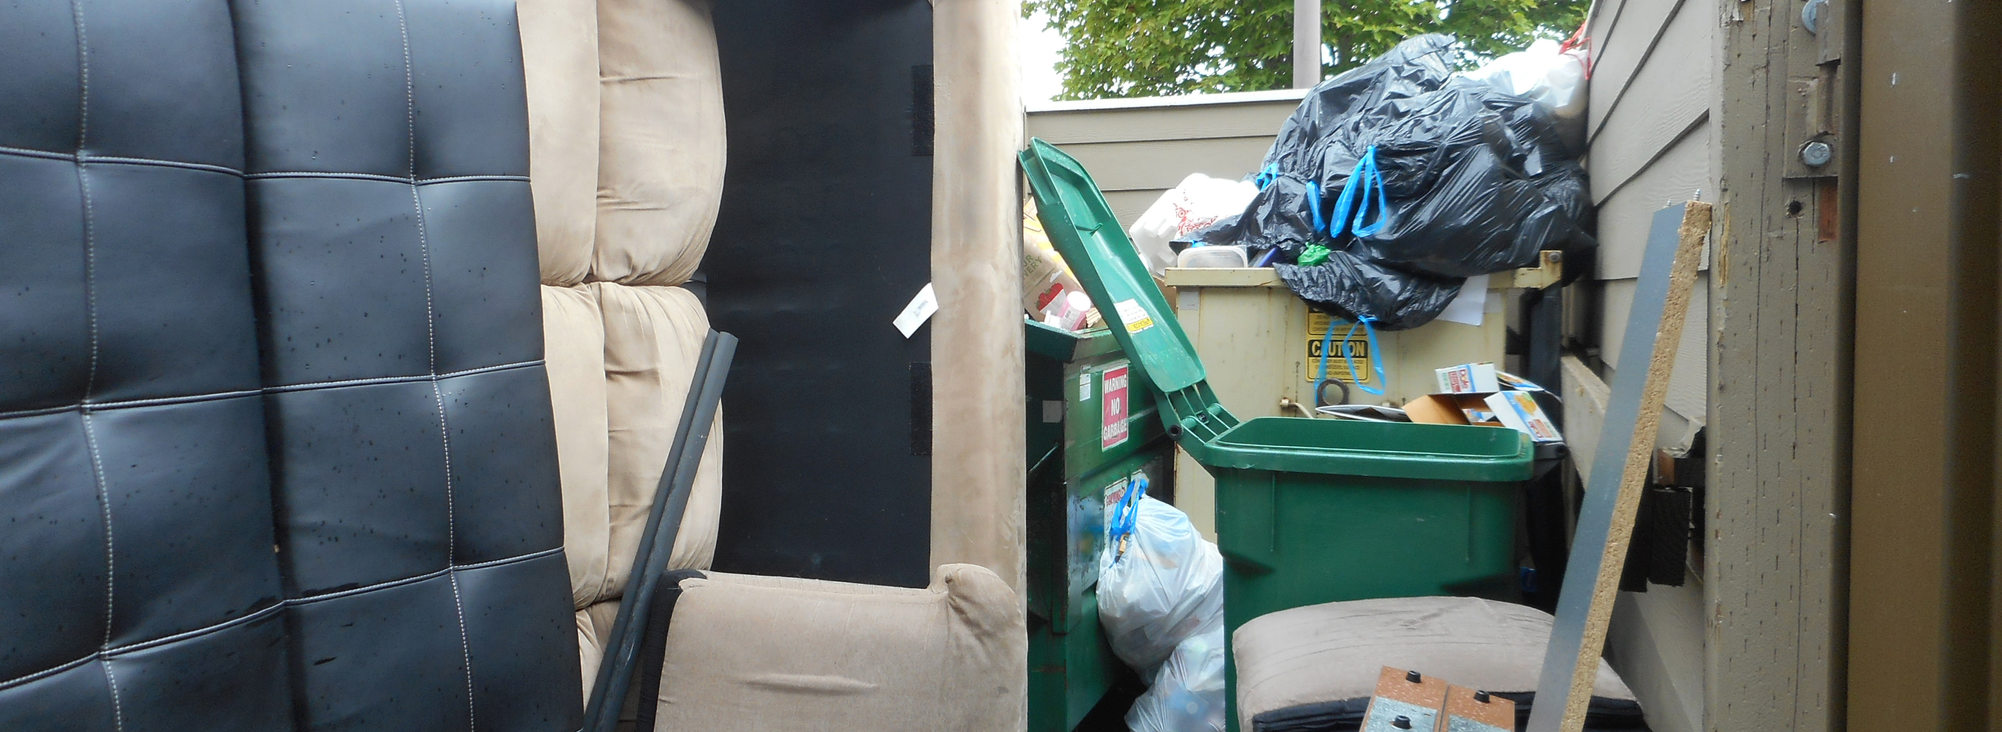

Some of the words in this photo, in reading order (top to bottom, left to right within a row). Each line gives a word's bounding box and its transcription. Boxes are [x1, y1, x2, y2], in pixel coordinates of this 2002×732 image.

[1312, 341, 1365, 356] CUTON
[1104, 374, 1127, 394] WARNING
[1111, 397, 1120, 416] NO
[1104, 418, 1127, 440] GARBAGE
